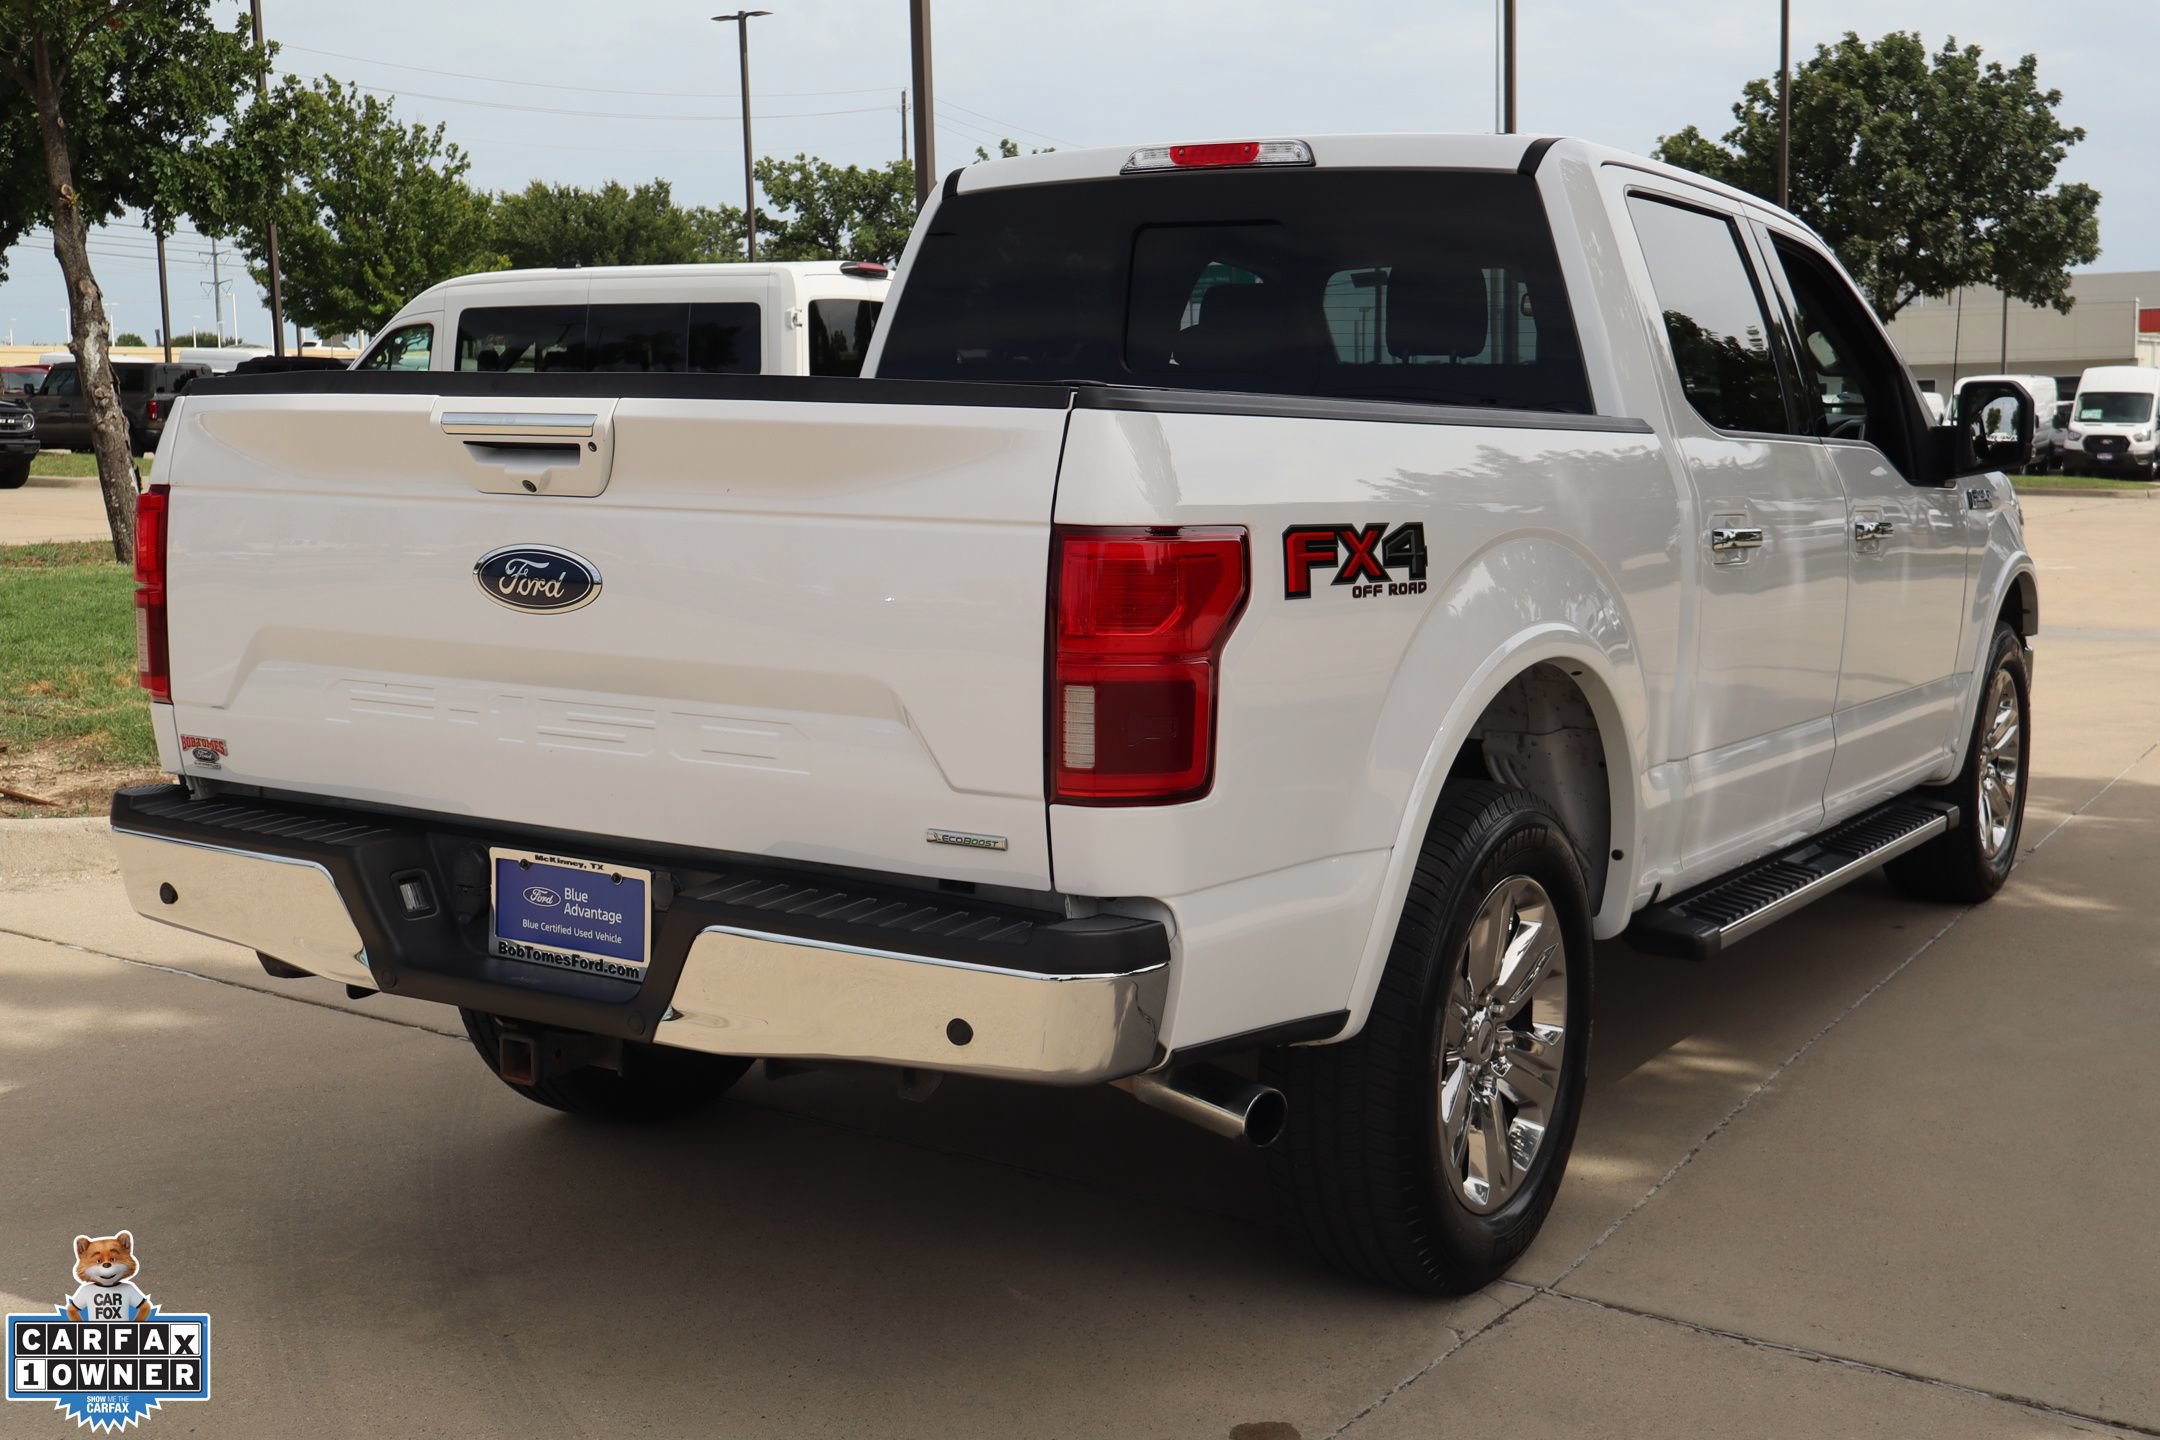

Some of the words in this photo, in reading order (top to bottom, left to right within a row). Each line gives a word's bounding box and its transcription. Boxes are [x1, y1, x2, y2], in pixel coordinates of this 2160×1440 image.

[1282, 522, 1428, 600] FX4
[498, 558, 567, 598] Ford
[1352, 584, 1383, 599] OFF
[1388, 581, 1428, 596] ROAD
[534, 854, 587, 869] McKinney,
[590, 861, 605, 871] TX
[529, 888, 555, 905] Ford
[564, 887, 589, 903] Blue
[564, 902, 623, 925] Advantage
[522, 918, 539, 930] Blue
[540, 921, 572, 936] Certified
[573, 928, 593, 939] Used
[595, 931, 623, 945] Vehicle
[498, 941, 640, 979] BobTomesFord.com
